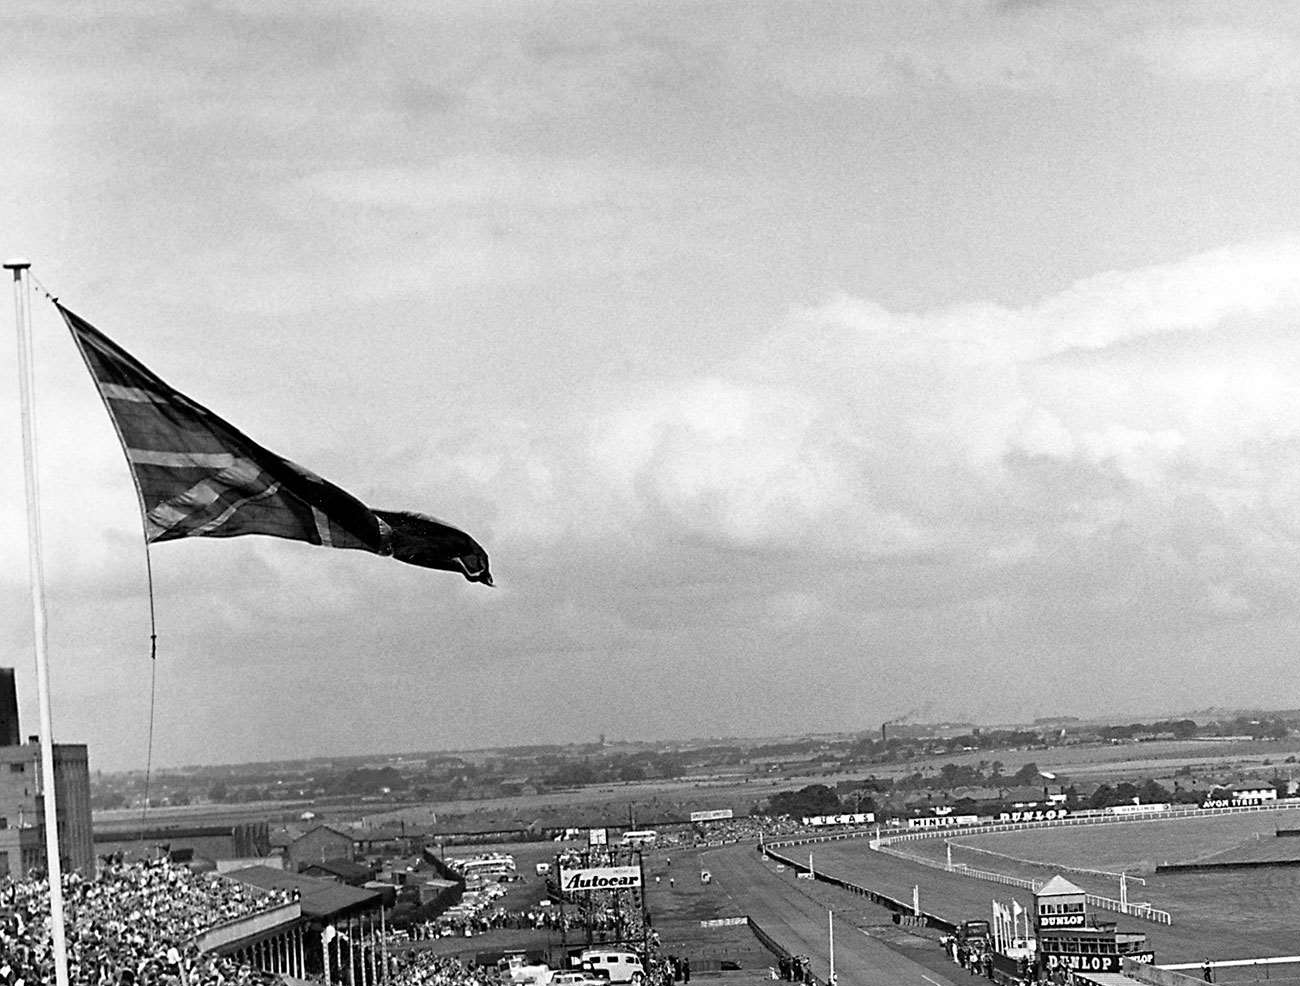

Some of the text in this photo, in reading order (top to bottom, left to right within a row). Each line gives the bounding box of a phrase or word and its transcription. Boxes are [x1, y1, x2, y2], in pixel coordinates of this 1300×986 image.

[1203, 800, 1229, 808] AVON
[808, 814, 869, 825] LUCAS
[1000, 810, 1068, 821] DUNLOP
[913, 817, 958, 827] MINTEX
[565, 873, 639, 889] Autocar
[1041, 916, 1084, 926] DUNLOP
[1048, 955, 1112, 970] DUNLOP
